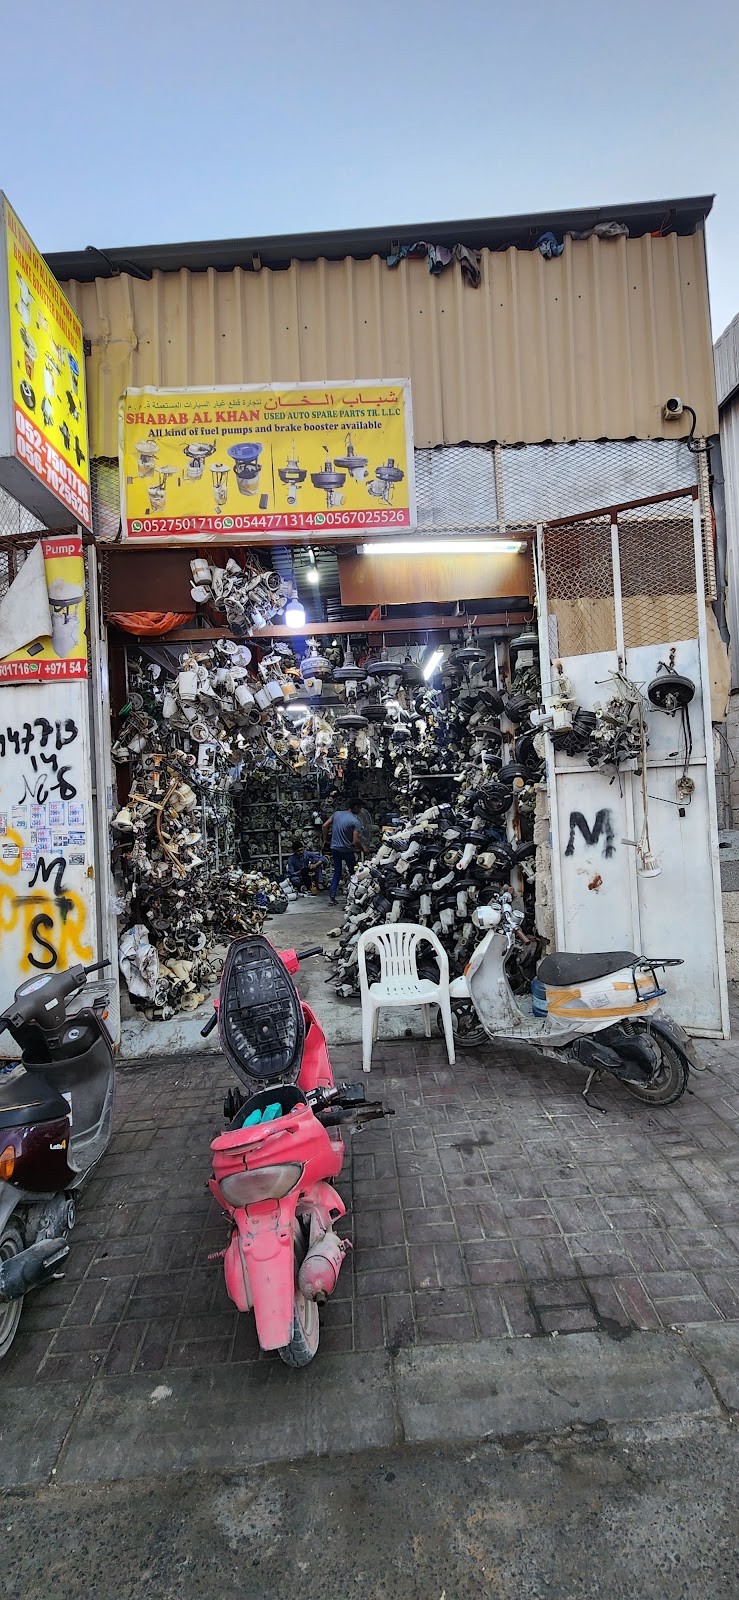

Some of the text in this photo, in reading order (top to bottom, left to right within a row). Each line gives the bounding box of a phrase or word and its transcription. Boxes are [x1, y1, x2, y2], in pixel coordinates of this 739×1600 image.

[184, 400, 210, 409] السيارات
[213, 399, 225, 408] غيار
[228, 398, 241, 409] قطع
[263, 393, 334, 411] الخان
[342, 391, 398, 407] شباب
[125, 412, 189, 425] SHABAB
[192, 411, 212, 424] AL
[215, 410, 260, 423] KHAN
[263, 411, 286, 420] USED
[287, 411, 310, 420] AUTO
[311, 410, 338, 419] SPARE
[339, 409, 365, 418] PARTS
[366, 409, 380, 417] TR.
[148, 420, 382, 437] All kind of fuel pumps and brake booster available
[15, 410, 89, 503] 052-7501716
[16, 433, 89, 523] 056-7025526
[143, 510, 404, 533] 0527501716 0544771314 0567025526
[45, 544, 76, 555] Pump
[45, 662, 67, 675] +971
[69, 661, 81, 674] 54
[564, 808, 616, 859] M
[28, 913, 58, 970] S
